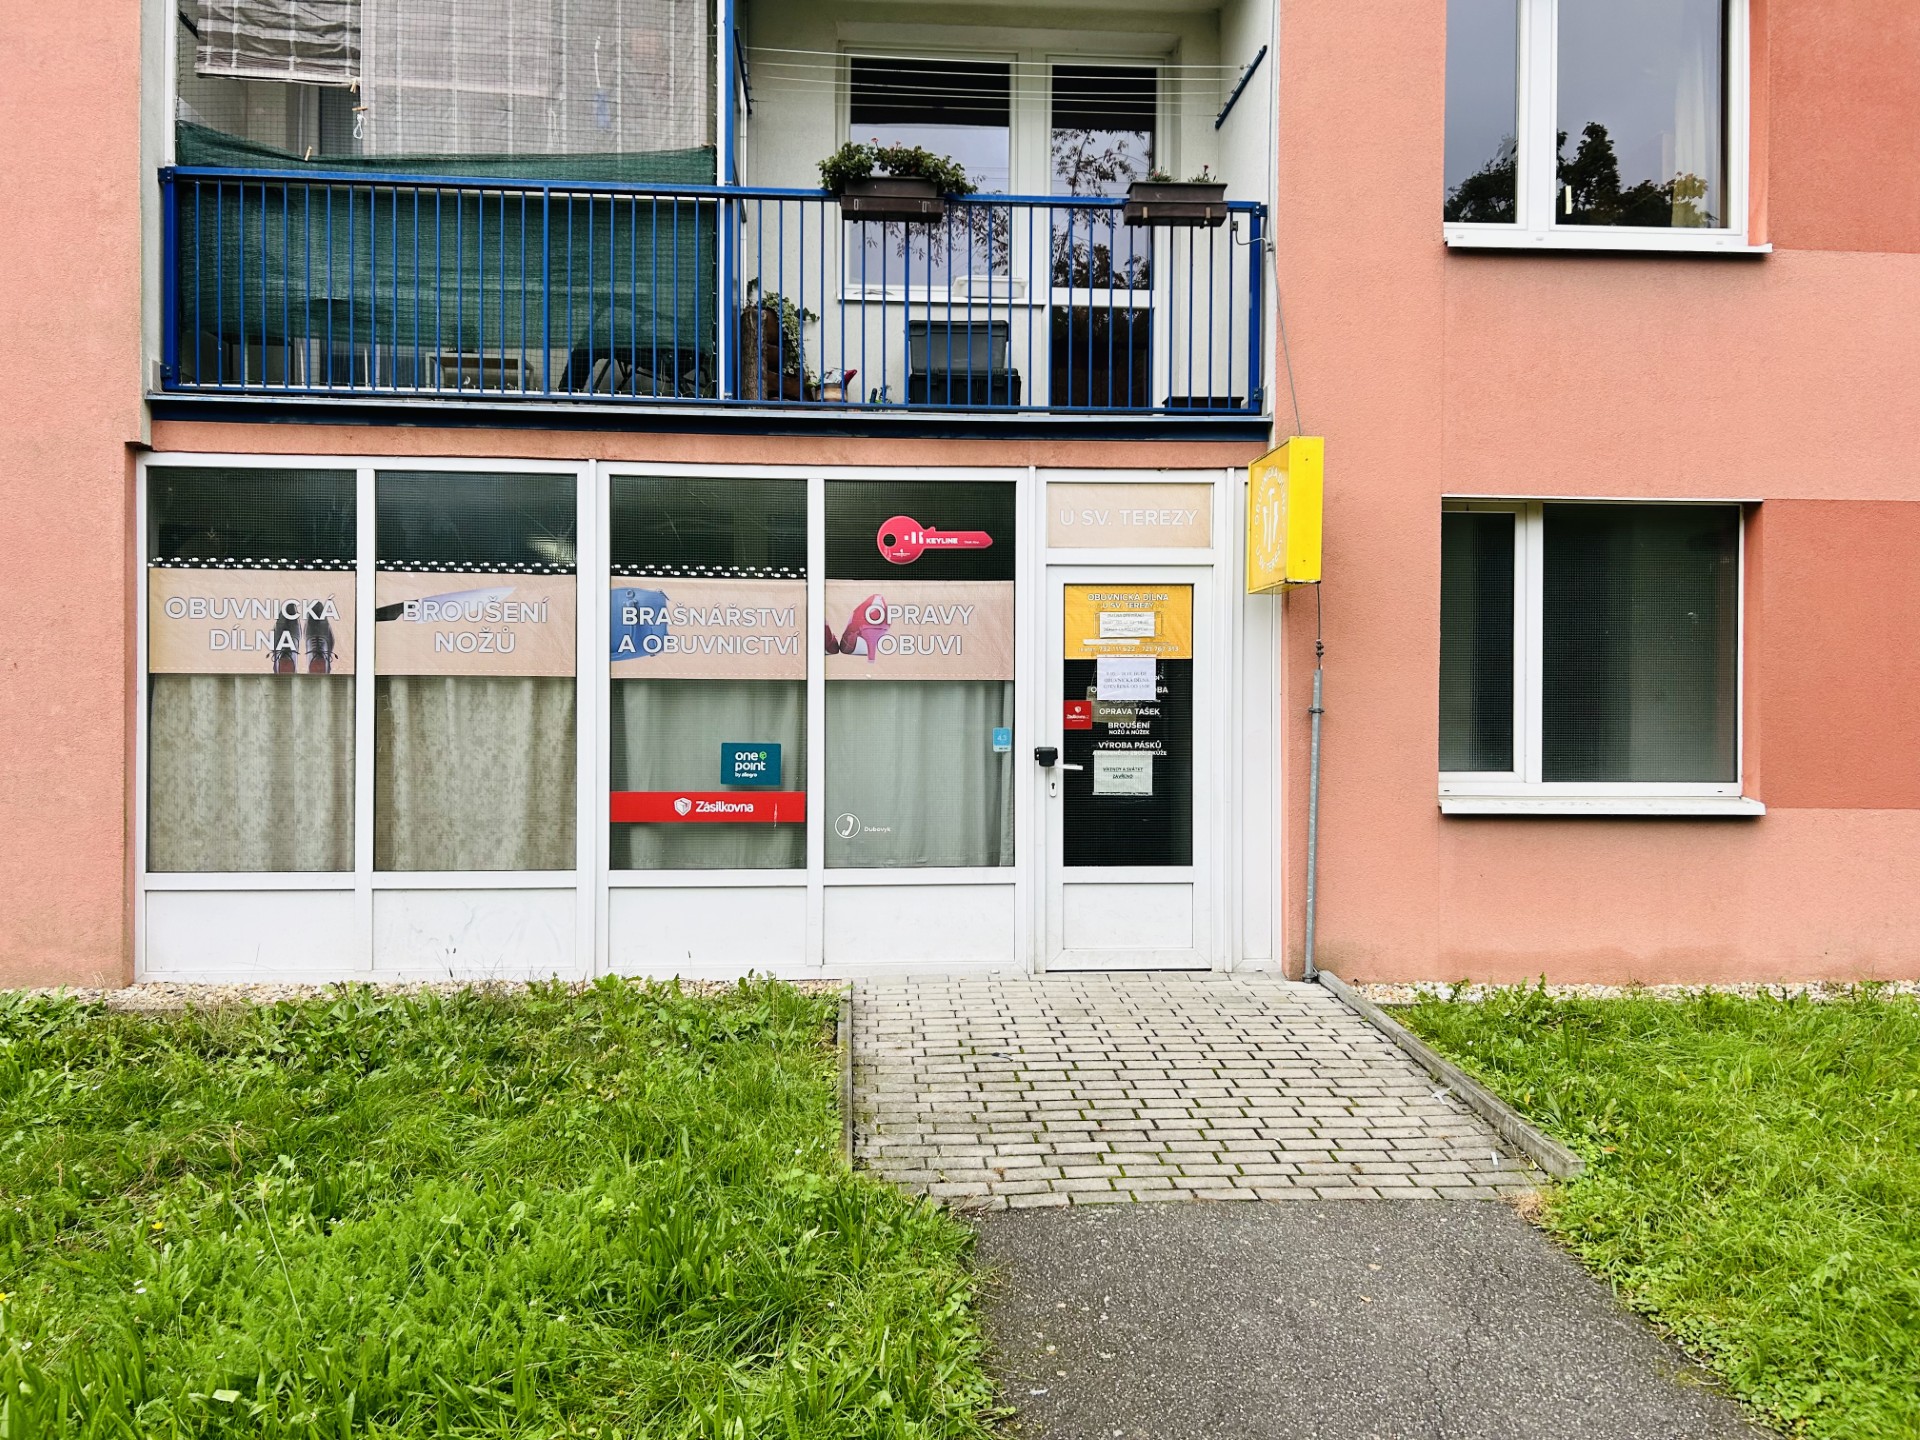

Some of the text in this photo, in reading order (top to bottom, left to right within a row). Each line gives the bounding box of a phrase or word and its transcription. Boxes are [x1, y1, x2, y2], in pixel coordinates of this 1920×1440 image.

[1060, 509, 1198, 526] U SV. TEREZY
[1087, 592, 1169, 601] OBUVNICKÁ DÍLNA
[165, 594, 341, 620] OBUVNICKÁ
[403, 596, 550, 623] BROUŠENÍ
[622, 603, 796, 627] BRAŠNÁŘSTVÍ
[865, 604, 974, 625] OPRAVY
[210, 625, 297, 651] DÍLNA
[435, 627, 515, 653] NOŽŮ
[618, 631, 800, 655] A OBUVNICTVÍ
[877, 635, 962, 655] OBUVI
[1134, 706, 1160, 715] TAŠEK
[1107, 720, 1151, 729] BROUŠENÍ
[1098, 740, 1162, 749] VÝROBA PÁSKŮ
[735, 752, 759, 761] one
[735, 761, 766, 772] point
[696, 801, 754, 812] Zásilkovna
